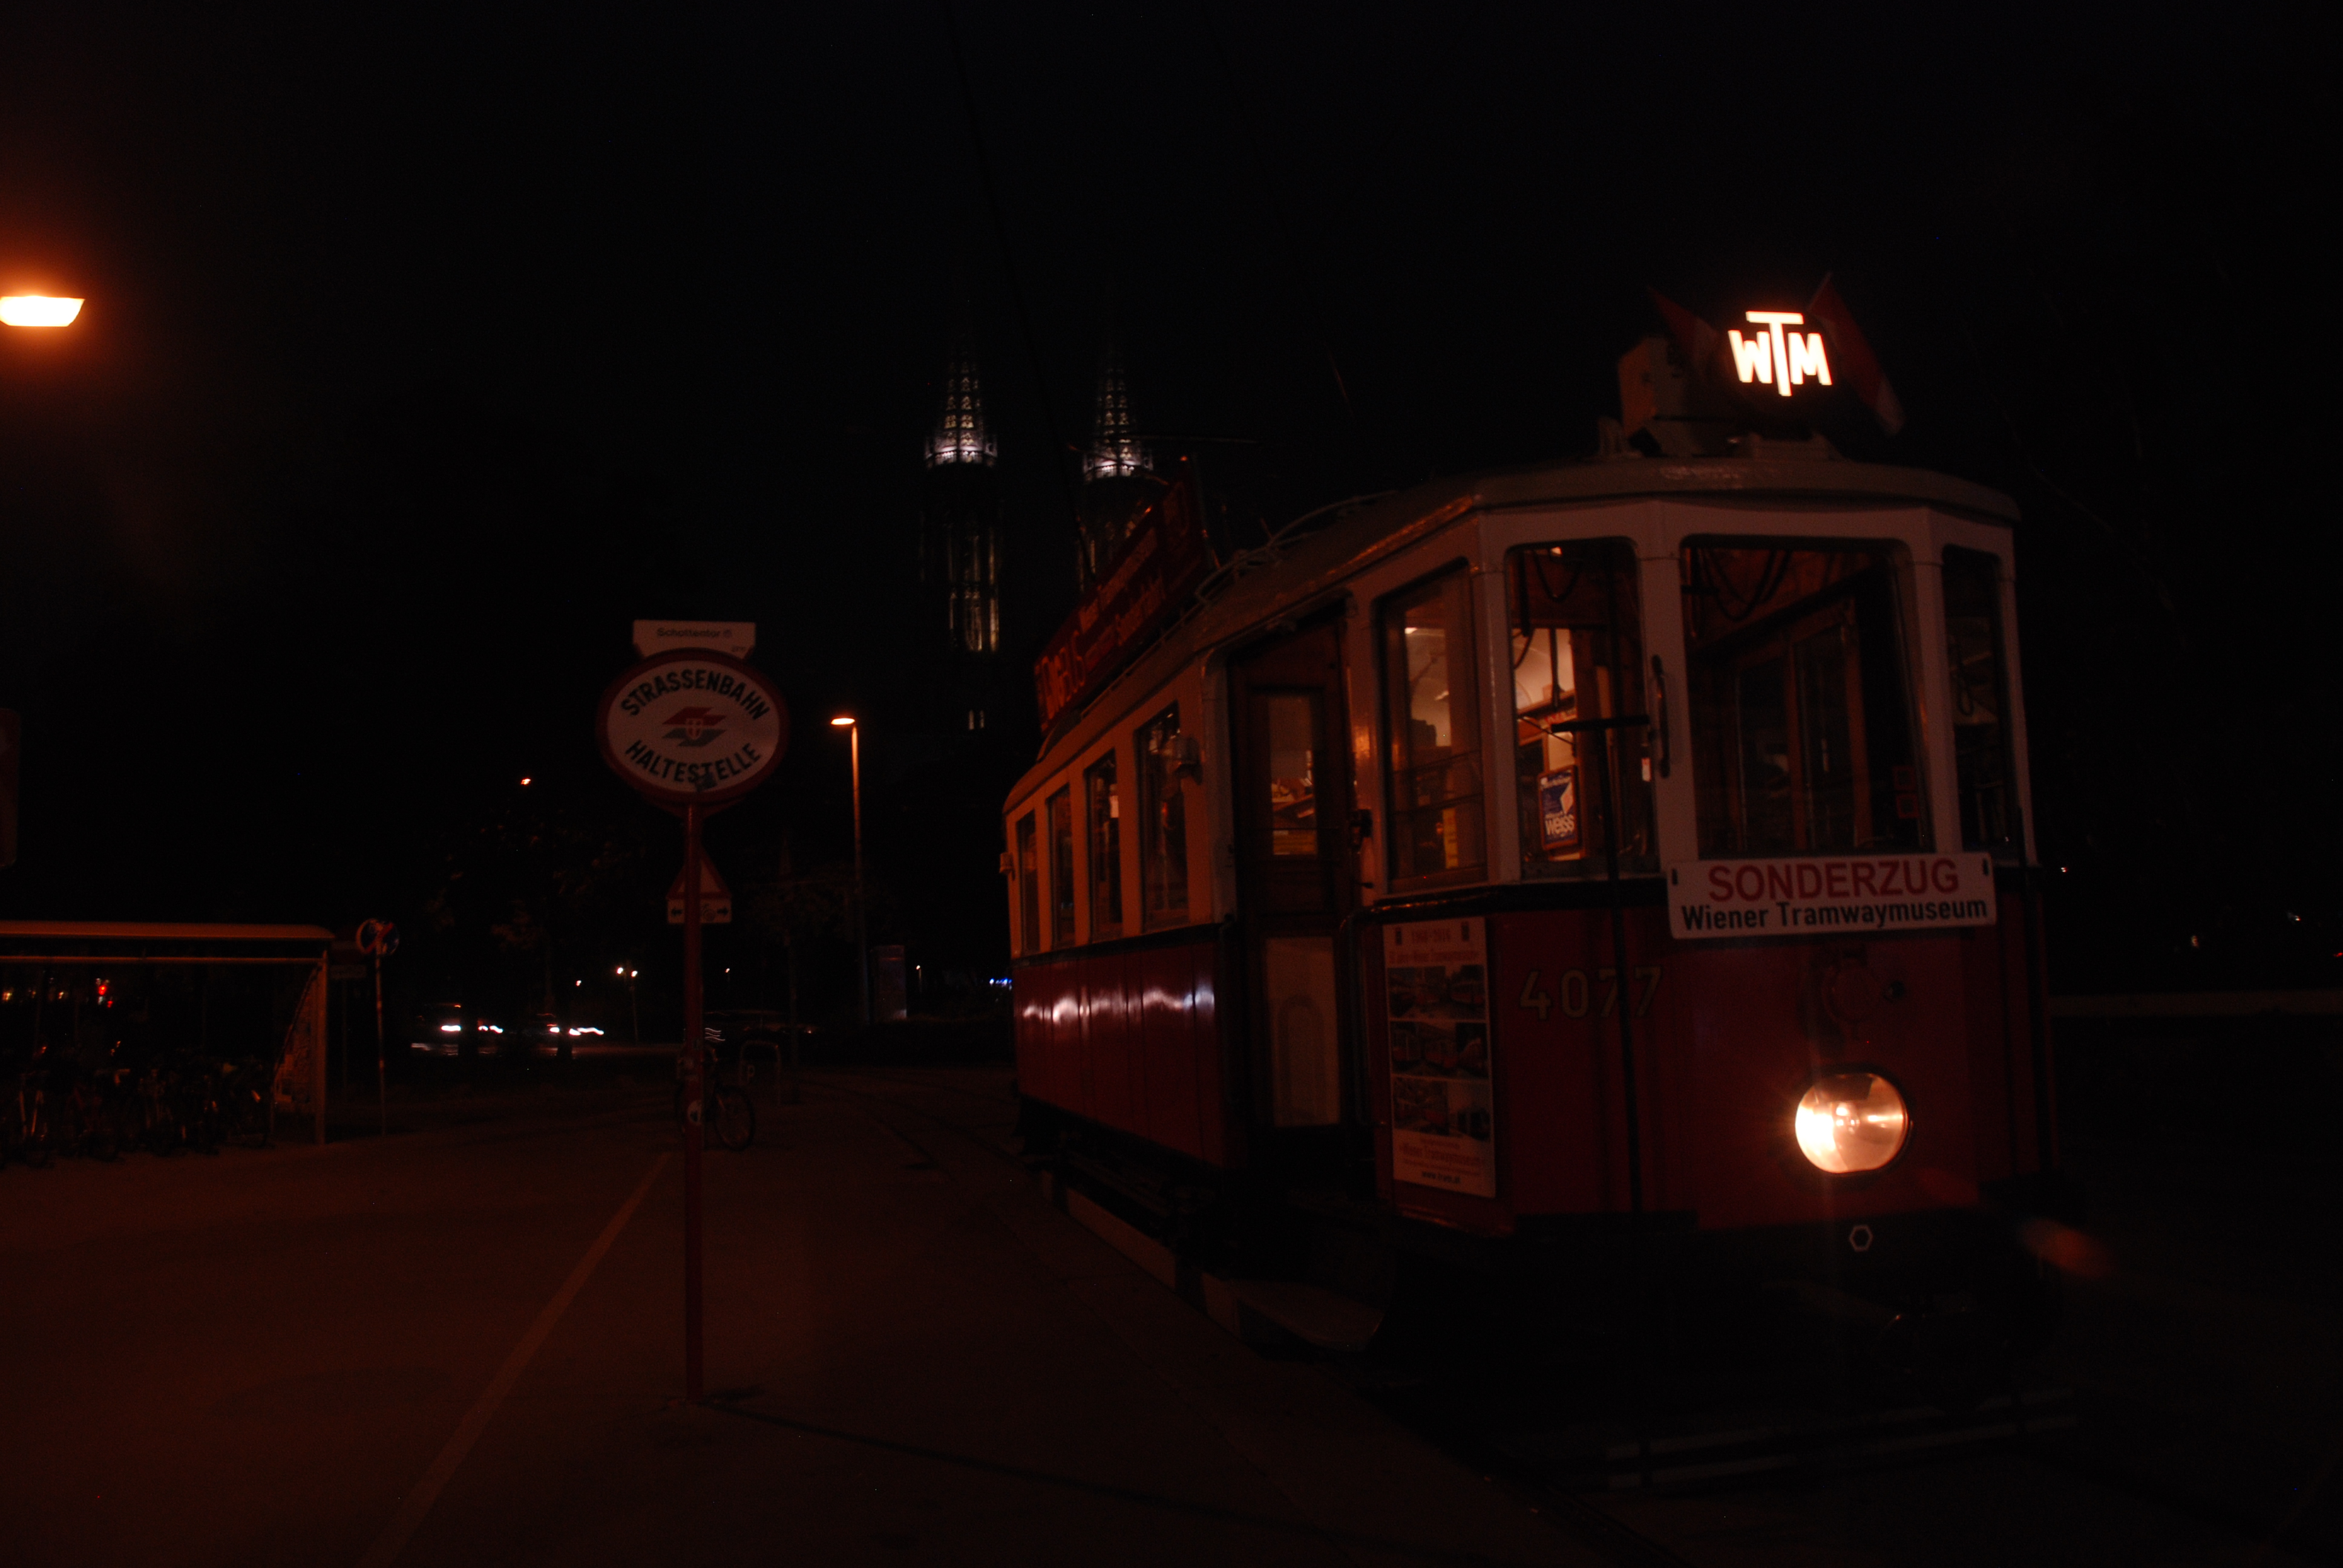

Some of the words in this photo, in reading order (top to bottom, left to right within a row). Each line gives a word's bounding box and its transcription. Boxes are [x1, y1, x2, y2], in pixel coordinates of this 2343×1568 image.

[1727, 310, 1833, 397] WTM
[621, 669, 770, 720] STRASSENBAHN
[626, 739, 761, 784] HALTESTELLE
[1708, 858, 1959, 902] SONDERZUG
[1682, 905, 1768, 930] Wiener
[1776, 900, 1987, 927] Tramwaymuseum
[1519, 967, 1663, 1021] 4077
